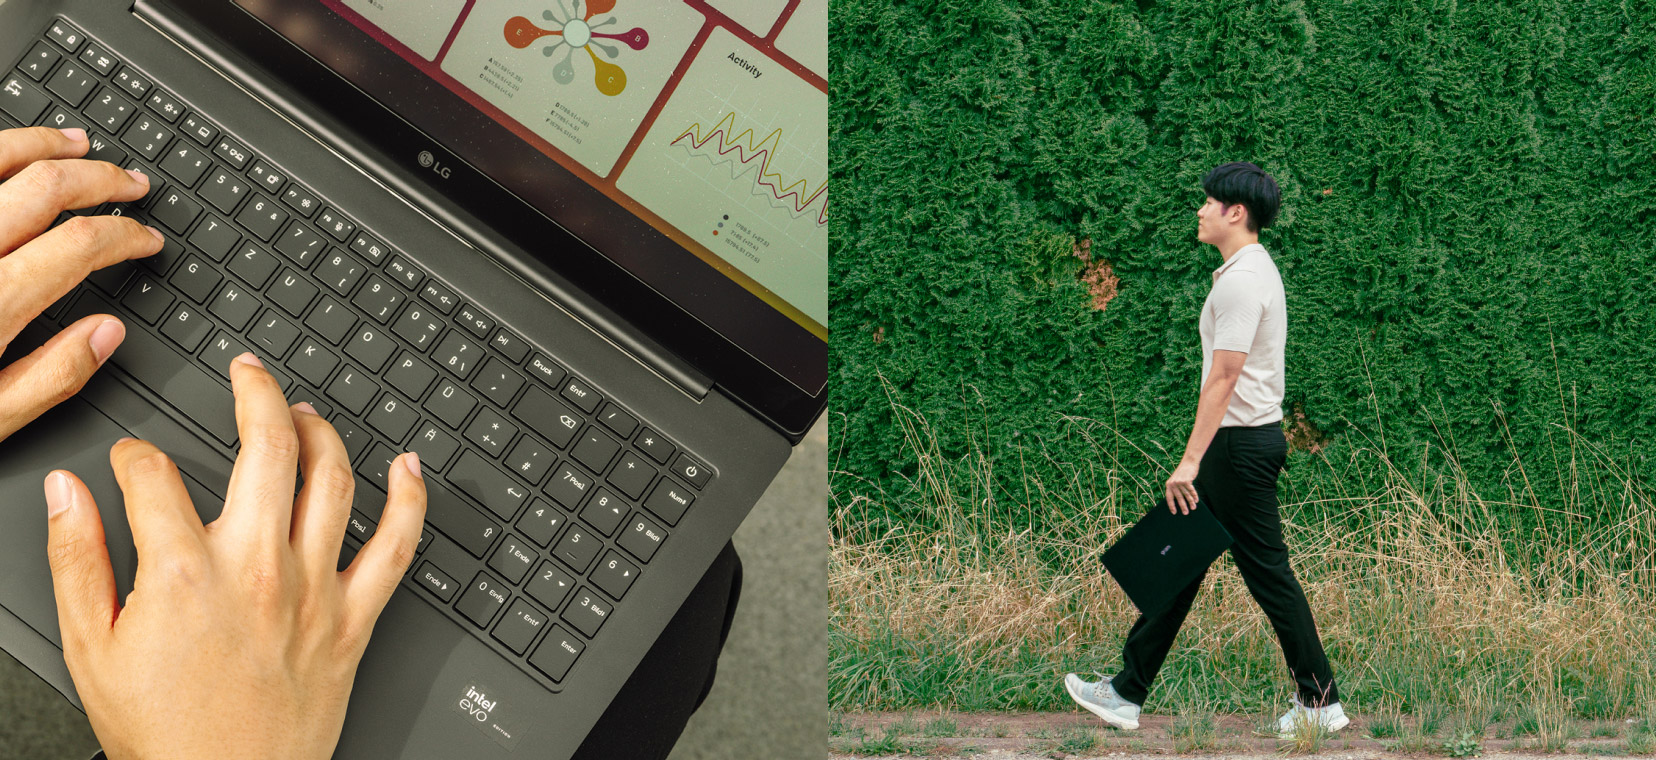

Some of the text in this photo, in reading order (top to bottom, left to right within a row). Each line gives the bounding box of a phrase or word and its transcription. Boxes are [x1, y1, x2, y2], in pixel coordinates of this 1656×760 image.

[727, 52, 763, 79] Activity
[103, 96, 111, 104] 2
[56, 114, 65, 125] Q
[140, 122, 149, 130] 3
[93, 140, 104, 151] W
[433, 161, 452, 179] LG
[217, 175, 225, 183] 5
[169, 195, 178, 204] R
[111, 208, 121, 217] D
[209, 222, 217, 230] T
[245, 249, 256, 259] Z
[333, 257, 341, 265] 8
[189, 264, 198, 273] G
[393, 263, 403, 271] F10
[285, 276, 295, 286] U
[142, 284, 151, 292] V
[372, 284, 380, 292] 9
[428, 287, 437, 295] F11
[227, 290, 237, 301] H
[326, 305, 332, 313] I
[179, 312, 188, 321] B
[463, 311, 473, 320] F12
[363, 332, 372, 341] O
[218, 339, 228, 349] N
[305, 346, 315, 356] K
[534, 360, 552, 375] Druck
[345, 374, 351, 384] L
[443, 386, 454, 397] Ü
[570, 385, 586, 397] Entf
[385, 401, 396, 412] Ö
[424, 428, 437, 442] Ä
[564, 471, 572, 479] 7
[599, 497, 608, 506] 8
[636, 523, 644, 531] 9
[572, 534, 580, 542] 5
[515, 550, 529, 563] Ende
[609, 560, 617, 568] 6
[426, 573, 441, 586] Ende
[544, 571, 552, 580] 2
[489, 590, 504, 603] Einfg
[581, 597, 590, 606] 3
[524, 614, 539, 626] Entf
[561, 641, 576, 653] Enter
[466, 686, 497, 713] intel
[459, 698, 487, 722] evo
